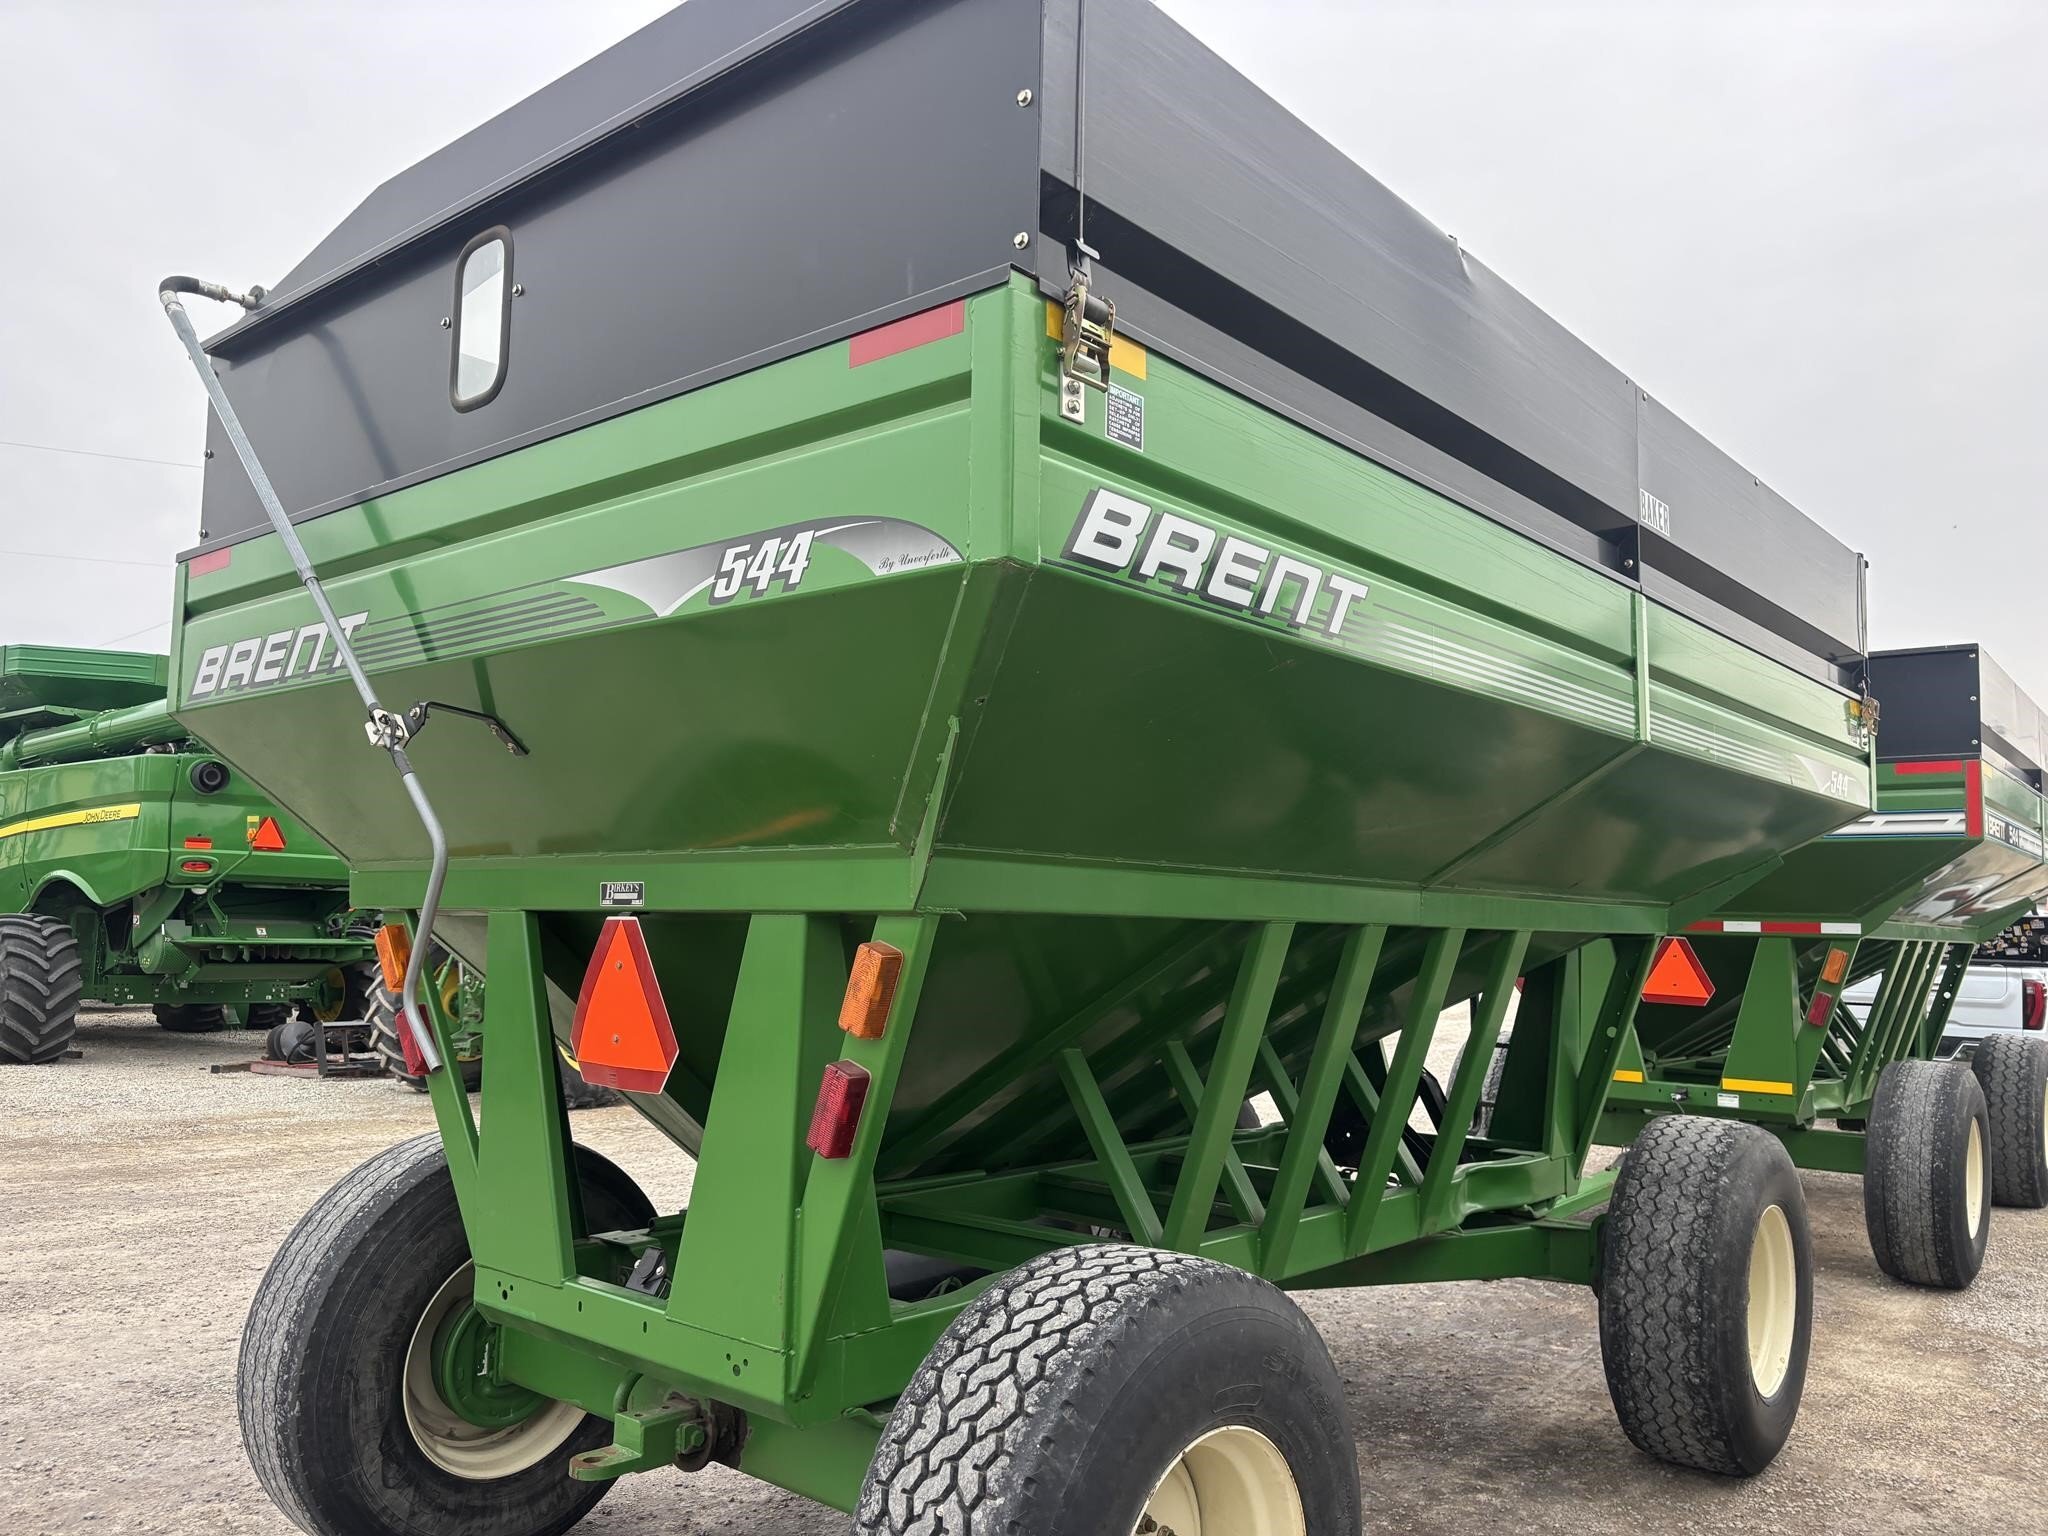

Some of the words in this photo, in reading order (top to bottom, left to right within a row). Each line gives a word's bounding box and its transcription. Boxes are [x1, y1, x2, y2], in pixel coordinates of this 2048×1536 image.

[1109, 385, 1139, 405] IMPORTANT
[1640, 490, 1669, 535] BAKER
[709, 530, 816, 605] 544
[879, 557, 894, 572] By
[1061, 488, 1369, 639] BRENT
[189, 610, 370, 702] BRENT
[1830, 770, 1848, 797] 544
[83, 812, 100, 821] JOHN
[101, 810, 121, 819] DEERE
